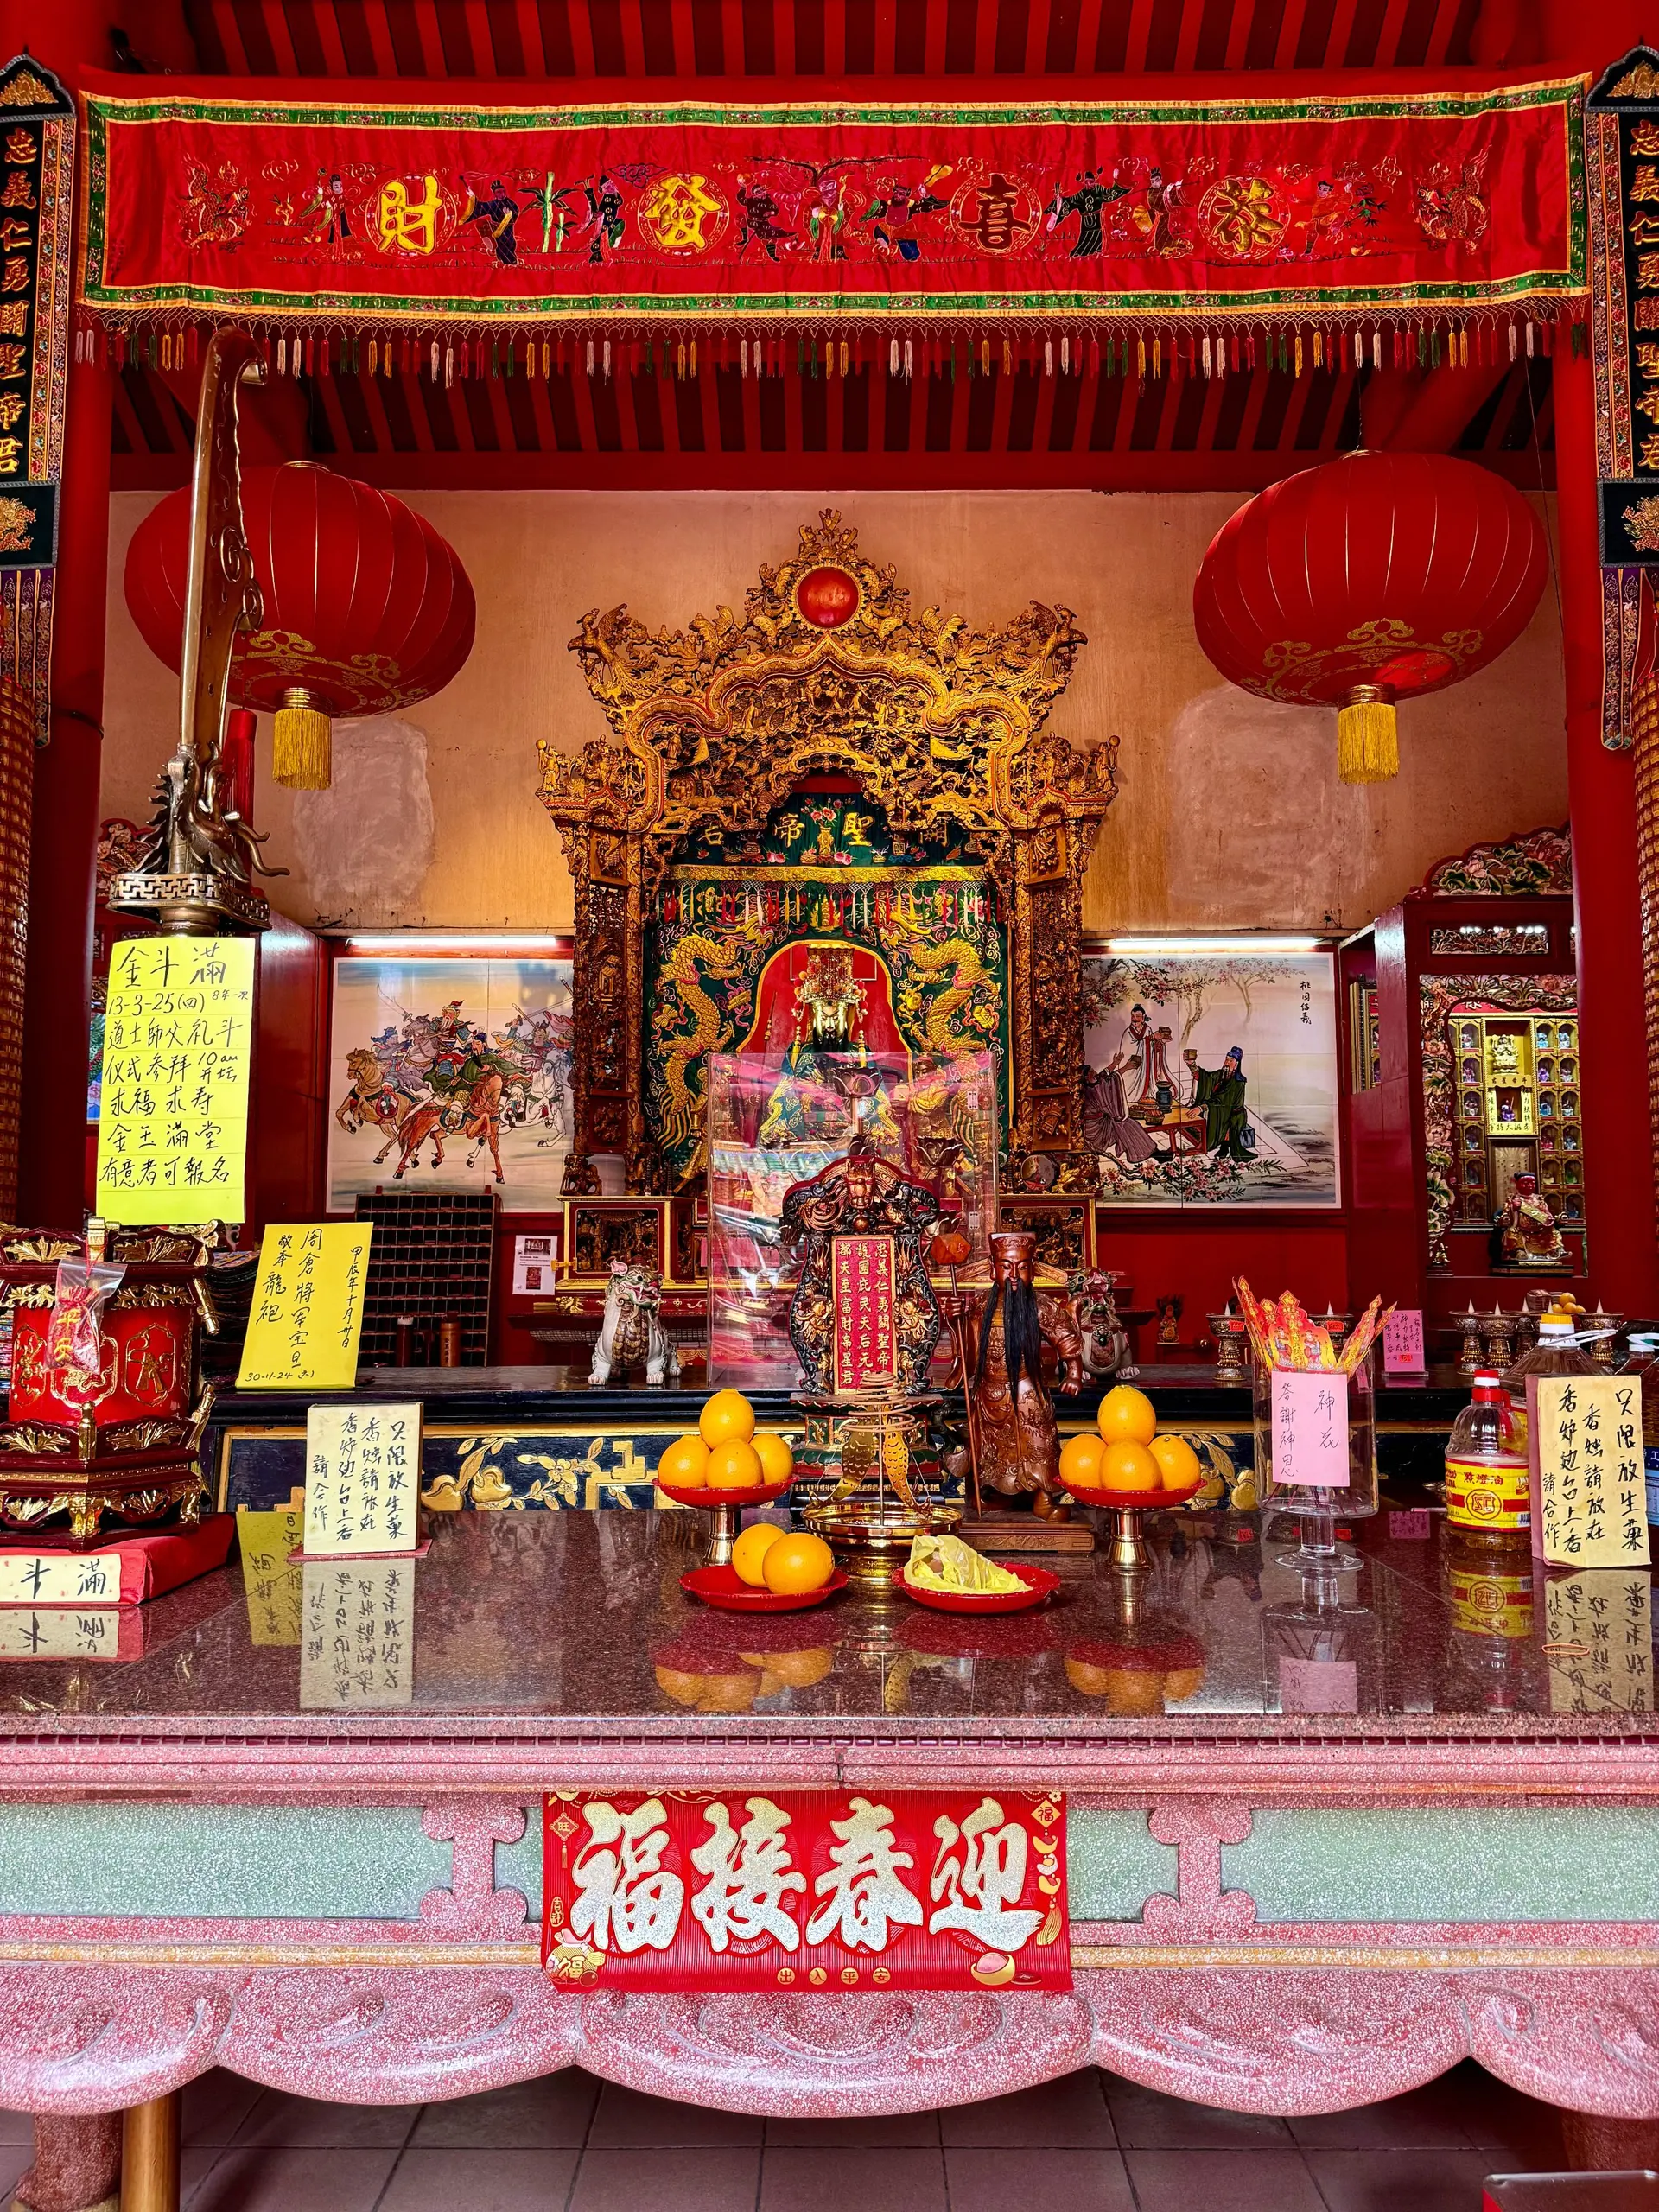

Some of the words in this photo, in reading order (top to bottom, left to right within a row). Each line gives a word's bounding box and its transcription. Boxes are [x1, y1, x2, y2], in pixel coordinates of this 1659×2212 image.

[874, 1243, 891, 1375] 忠義仁勇關聖帝
[1038, 1806, 1054, 1822] 福
[557, 1821, 571, 1833] 旺
[570, 1796, 1045, 1954] 迎春接福
[557, 1955, 586, 1979] 福
[779, 1968, 888, 1984] 出入平安
